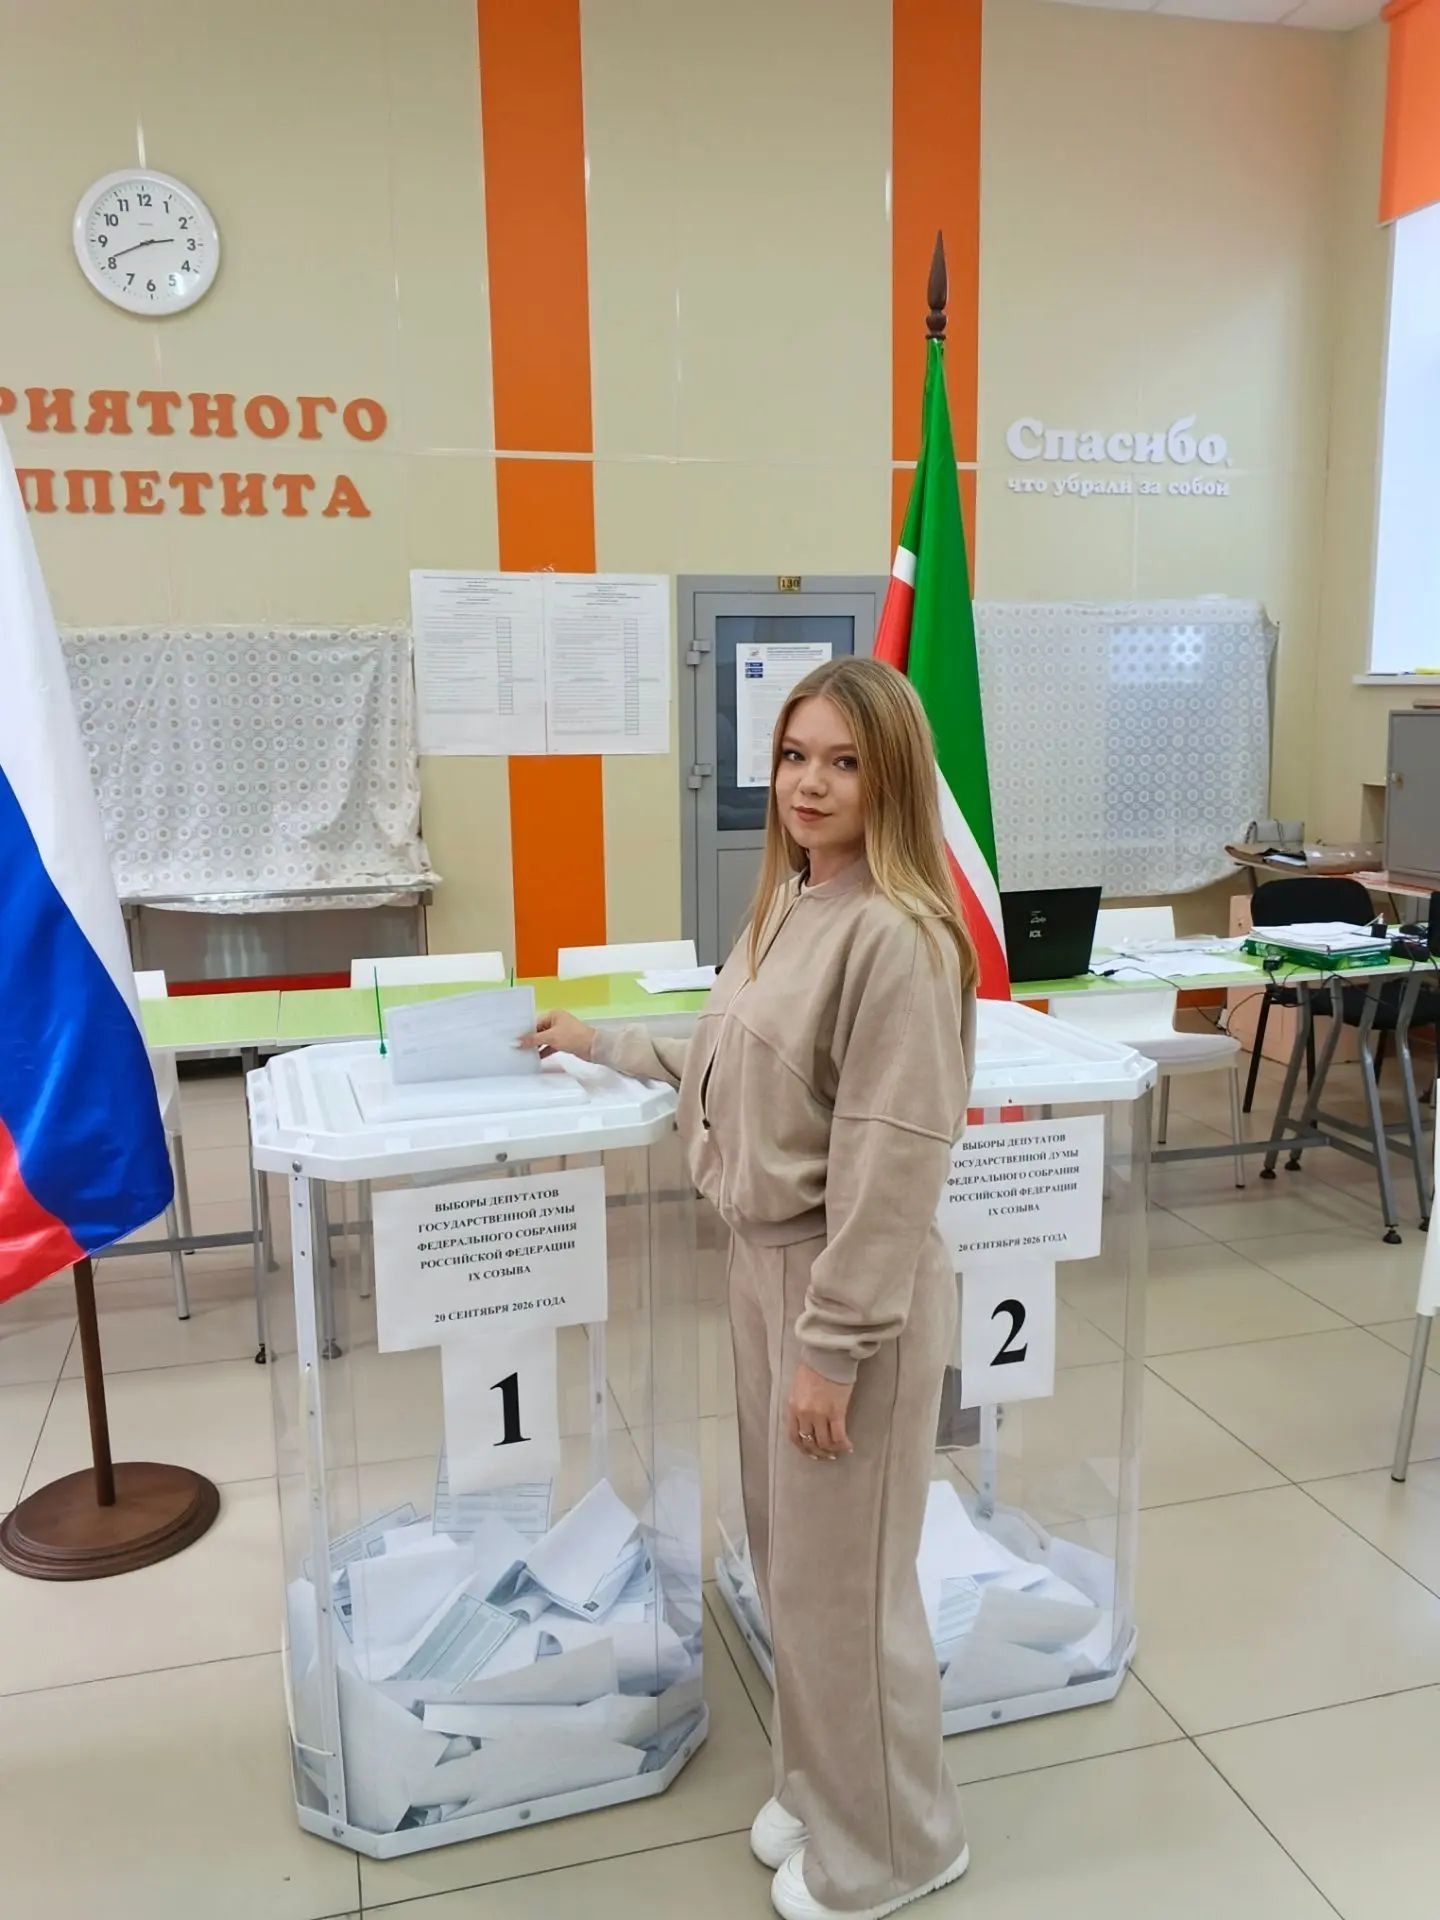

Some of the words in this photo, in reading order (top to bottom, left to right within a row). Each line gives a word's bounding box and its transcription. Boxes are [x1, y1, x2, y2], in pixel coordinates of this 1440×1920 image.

[118, 199, 129, 212] 11
[137, 193, 152, 207] 12
[163, 200, 169, 214] 1
[104, 213, 119, 227] 10
[178, 217, 188, 230] 2
[98, 234, 108, 248] 9
[186, 238, 196, 251] 3
[107, 256, 117, 270] 8
[181, 260, 191, 272] 4
[126, 273, 135, 286] 7
[146, 279, 156, 292] 6
[168, 274, 178, 287] 5
[15, 468, 371, 518] ППЕТИТА
[1008, 476, 1047, 494] что
[1052, 473, 1132, 499] убрали
[1139, 481, 1161, 495] за
[1168, 476, 1230, 497] собой
[962, 1138, 1006, 1152] ВЫБОРЫ
[1007, 1133, 1066, 1148] ДЕПУТАТОВ
[1048, 1148, 1079, 1161] ДУМЫ
[946, 1171, 1027, 1187] ФЕДЕРАЛЬНОГО
[1028, 1165, 1080, 1179] СОБРАНИЯ
[434, 1198, 487, 1213] ВЫБОРЫ
[489, 1188, 560, 1207] ДЕПУТАТОВ
[949, 1187, 1018, 1204] РОССИЙСКОЙ
[1019, 1181, 1078, 1197] ФЕДЕРАЦИИ
[988, 1207, 999, 1216] IX
[1000, 1203, 1041, 1216] СОЗЫВА
[417, 1208, 537, 1234] ГОСУДАРСТВЕННОЙ
[538, 1204, 576, 1219] ДУМЫ
[416, 1231, 513, 1252] ФЕДЕРАЛЬНОГО
[515, 1221, 578, 1239] СОБРАНИЯ
[958, 1243, 969, 1253] 20
[969, 1236, 1021, 1251] СЕНТЯБРЯ
[1022, 1236, 1041, 1246] 2026
[1042, 1232, 1068, 1244] ГОДА
[420, 1249, 503, 1270] РОССИЙСКОЙ
[505, 1239, 576, 1259] ФЕДЕРАЦИИ
[468, 1272, 481, 1282] IX
[483, 1264, 532, 1280] СОЗЫВА
[434, 1313, 446, 1323] 20
[448, 1303, 509, 1321] СЕНТЯБРЯ
[512, 1301, 534, 1312] 2026
[536, 1295, 567, 1308] ГОДА
[990, 1298, 1029, 1367] 2
[490, 1371, 532, 1447] 1
